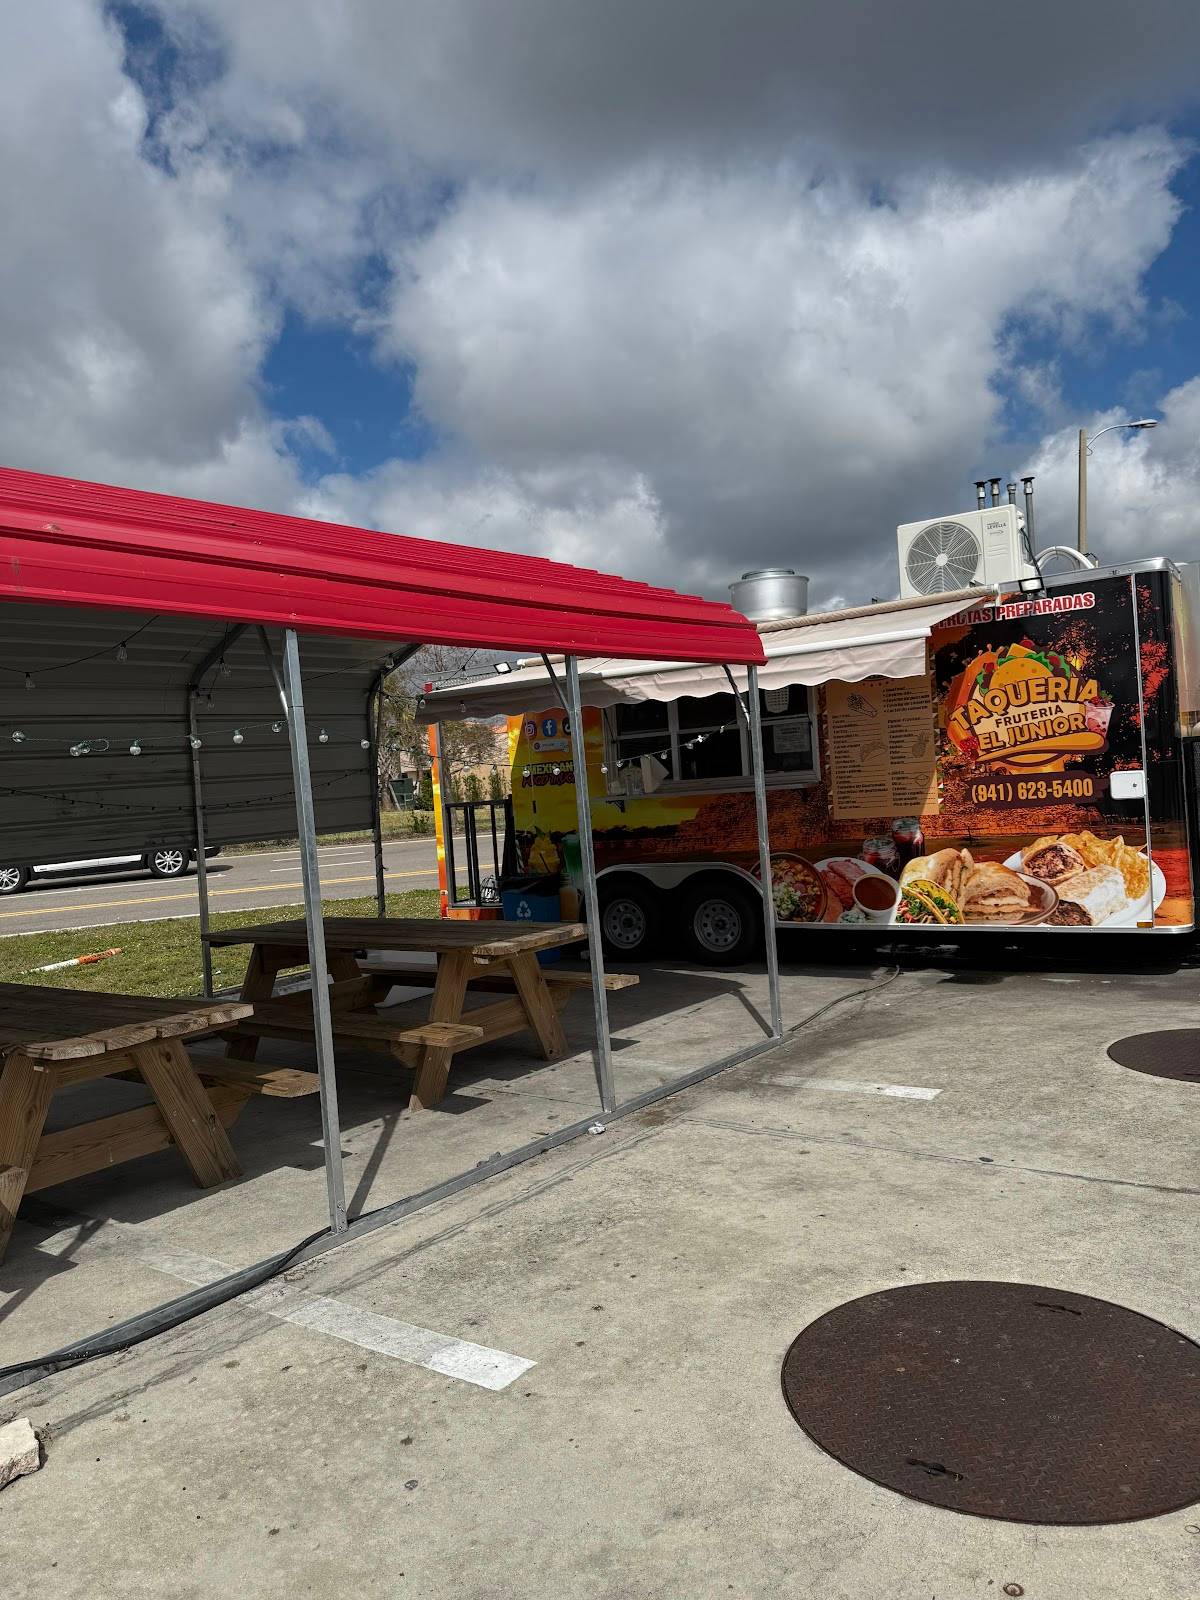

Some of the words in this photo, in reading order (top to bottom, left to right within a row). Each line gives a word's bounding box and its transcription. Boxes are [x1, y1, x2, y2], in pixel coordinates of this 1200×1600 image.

[995, 592, 1095, 620] PREPARADAS
[950, 676, 1098, 730] TAQUERIA
[995, 705, 1064, 728] FRUTERIA
[978, 731, 1005, 750] EL
[1007, 713, 1087, 746] JUNIOR
[971, 783, 1013, 803] (941)
[1017, 778, 1094, 800] 623-5400
